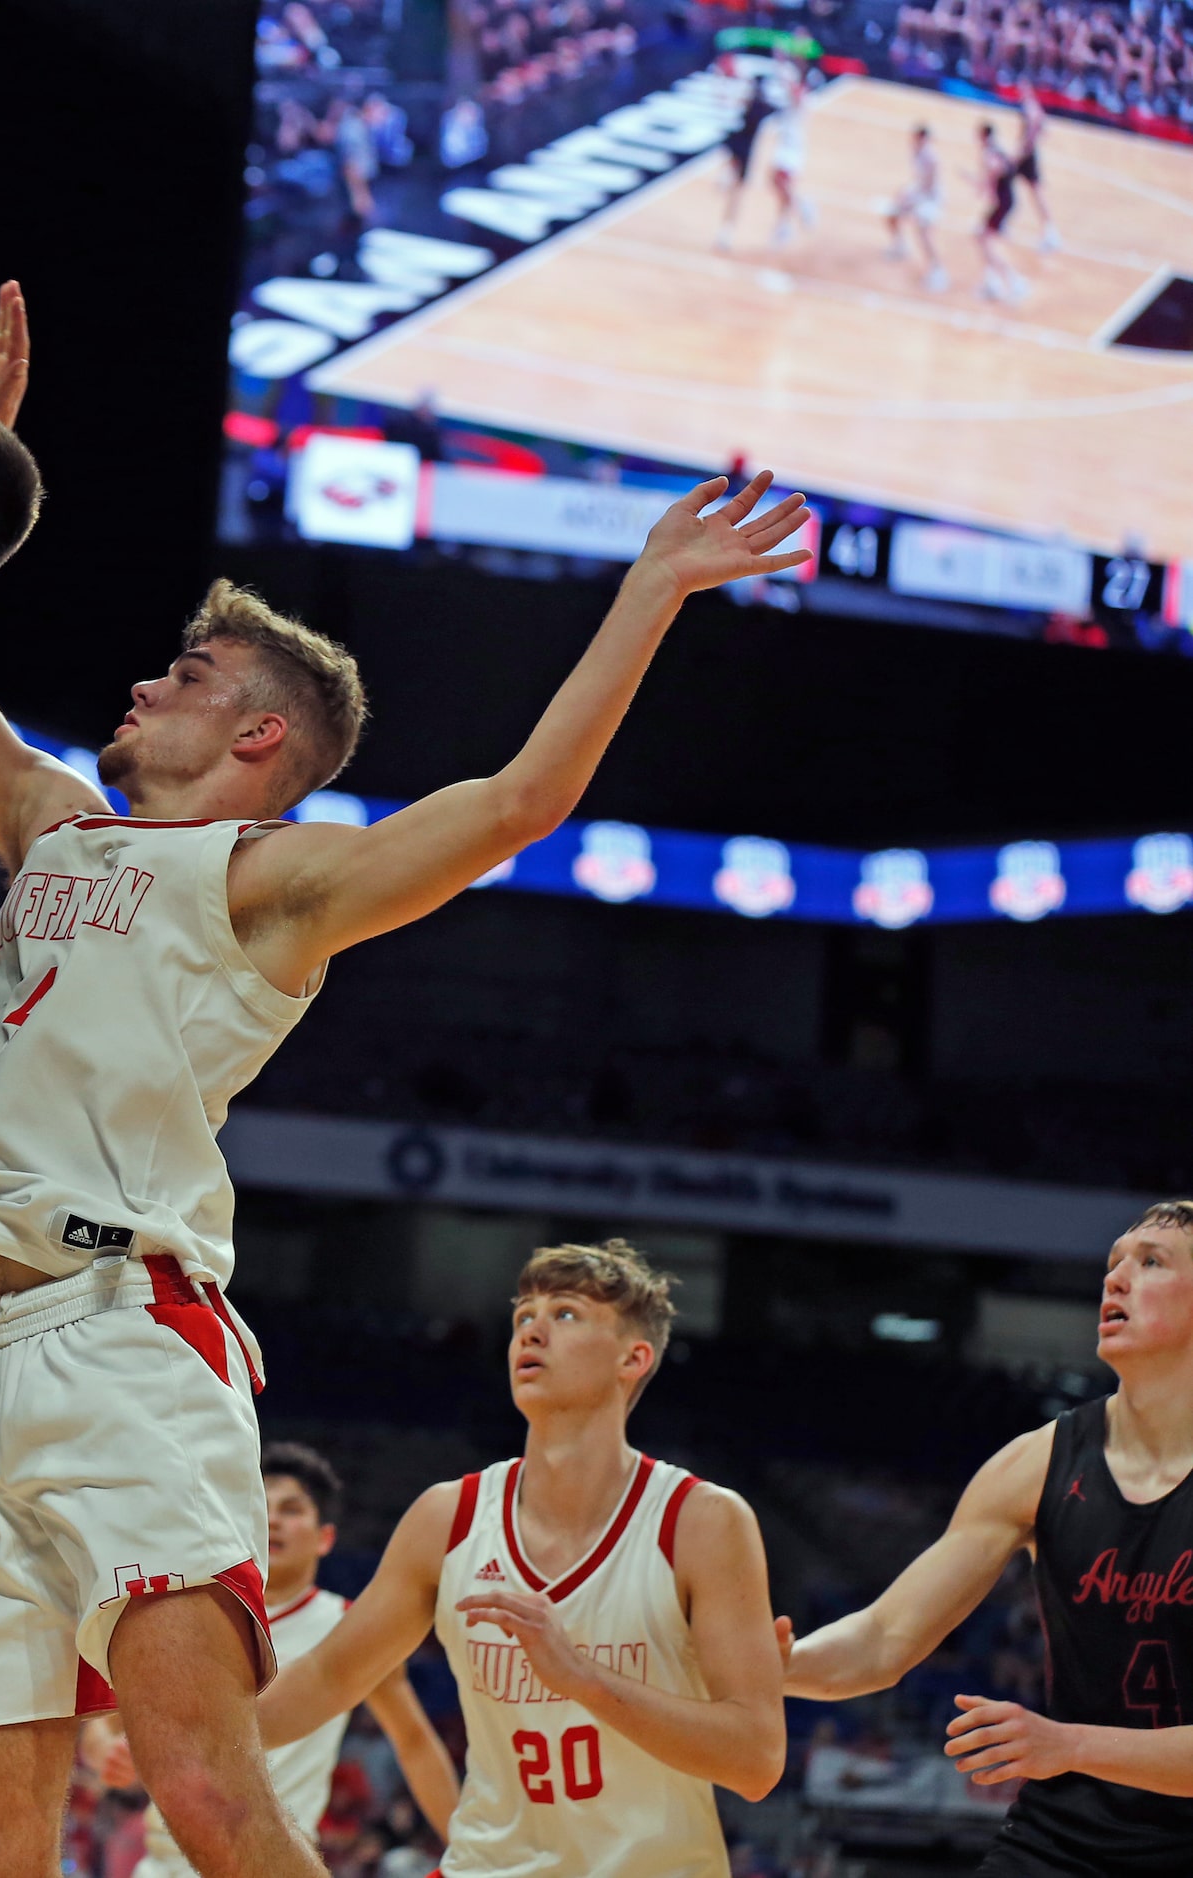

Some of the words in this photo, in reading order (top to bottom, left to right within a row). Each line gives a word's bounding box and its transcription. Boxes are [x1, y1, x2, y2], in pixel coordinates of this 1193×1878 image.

[829, 523, 879, 578] 41
[1103, 556, 1150, 611] 27
[68, 1233, 94, 1245] adidas
[1072, 1547, 1193, 1624] Argyle
[1122, 1639, 1183, 1729] 4
[512, 1724, 604, 1805] 20
